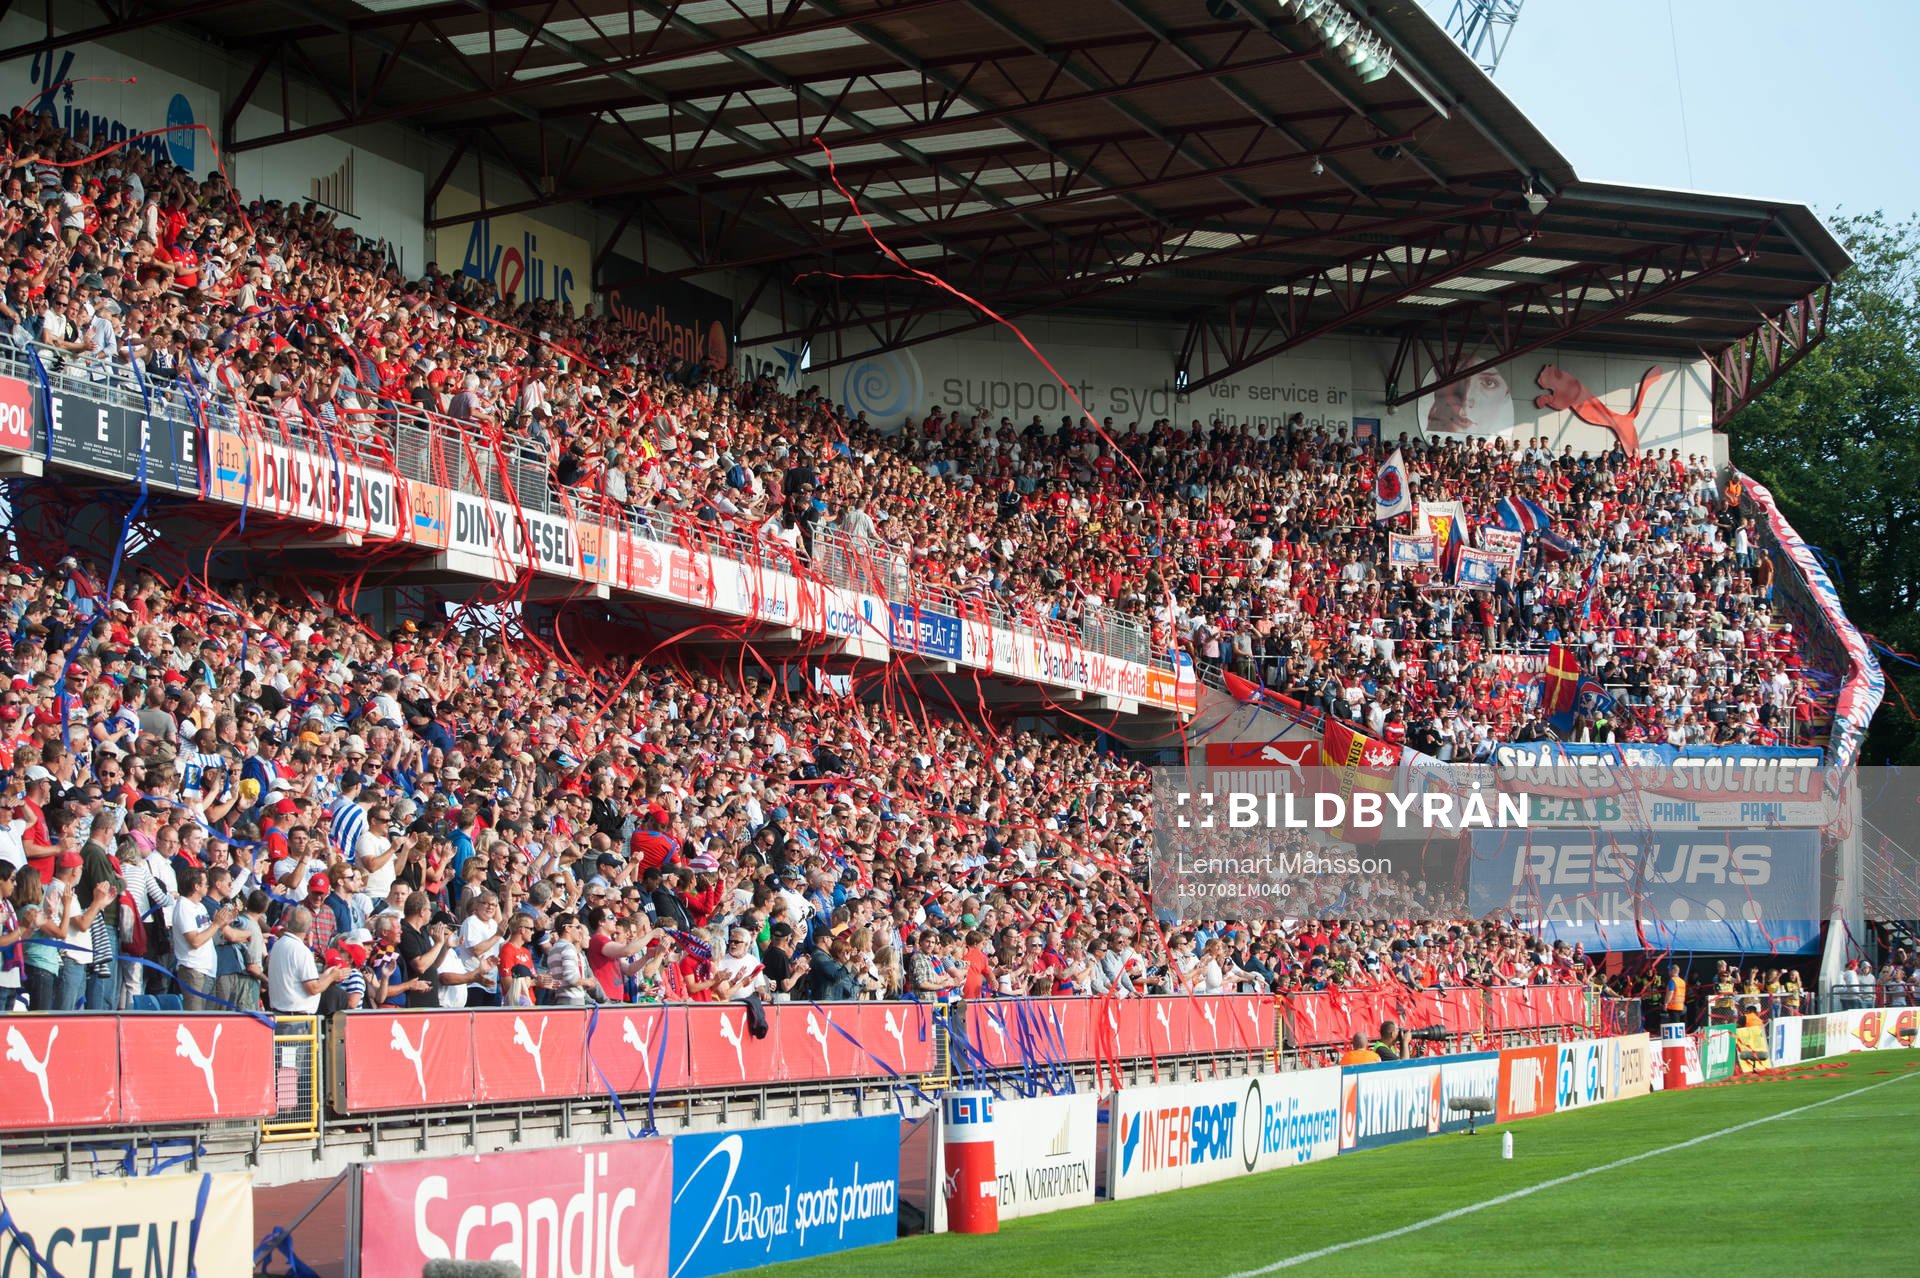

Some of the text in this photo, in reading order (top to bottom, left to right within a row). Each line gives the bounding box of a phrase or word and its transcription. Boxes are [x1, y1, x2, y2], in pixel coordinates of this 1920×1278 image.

[462, 217, 574, 312] Akelius
[610, 290, 704, 364] Swedbank
[943, 378, 1169, 424] support syd
[1208, 379, 1240, 399] vår
[1248, 383, 1318, 403] service
[1327, 387, 1347, 404] är
[52, 397, 63, 431] E
[98, 409, 109, 441] E
[1247, 412, 1347, 435] upplvelse
[183, 430, 194, 462] E
[1118, 665, 1146, 698] media
[1213, 770, 1291, 797] PUMA
[1498, 744, 1616, 788] SKÅNES
[1673, 756, 1818, 794] STOLTHET
[1653, 802, 1701, 822] PAMIL
[1741, 802, 1787, 822] PAMIL
[1512, 844, 1772, 886] RESURS
[1263, 1097, 1337, 1163] Rörläggaren
[1358, 1080, 1429, 1138] STRYKTIPSET
[1142, 1101, 1237, 1173] INTERSPORT
[1024, 1160, 1090, 1202] NORRPORTEN
[415, 1152, 636, 1278] Scandic
[723, 1161, 895, 1253] DeRoyal sports pharma
